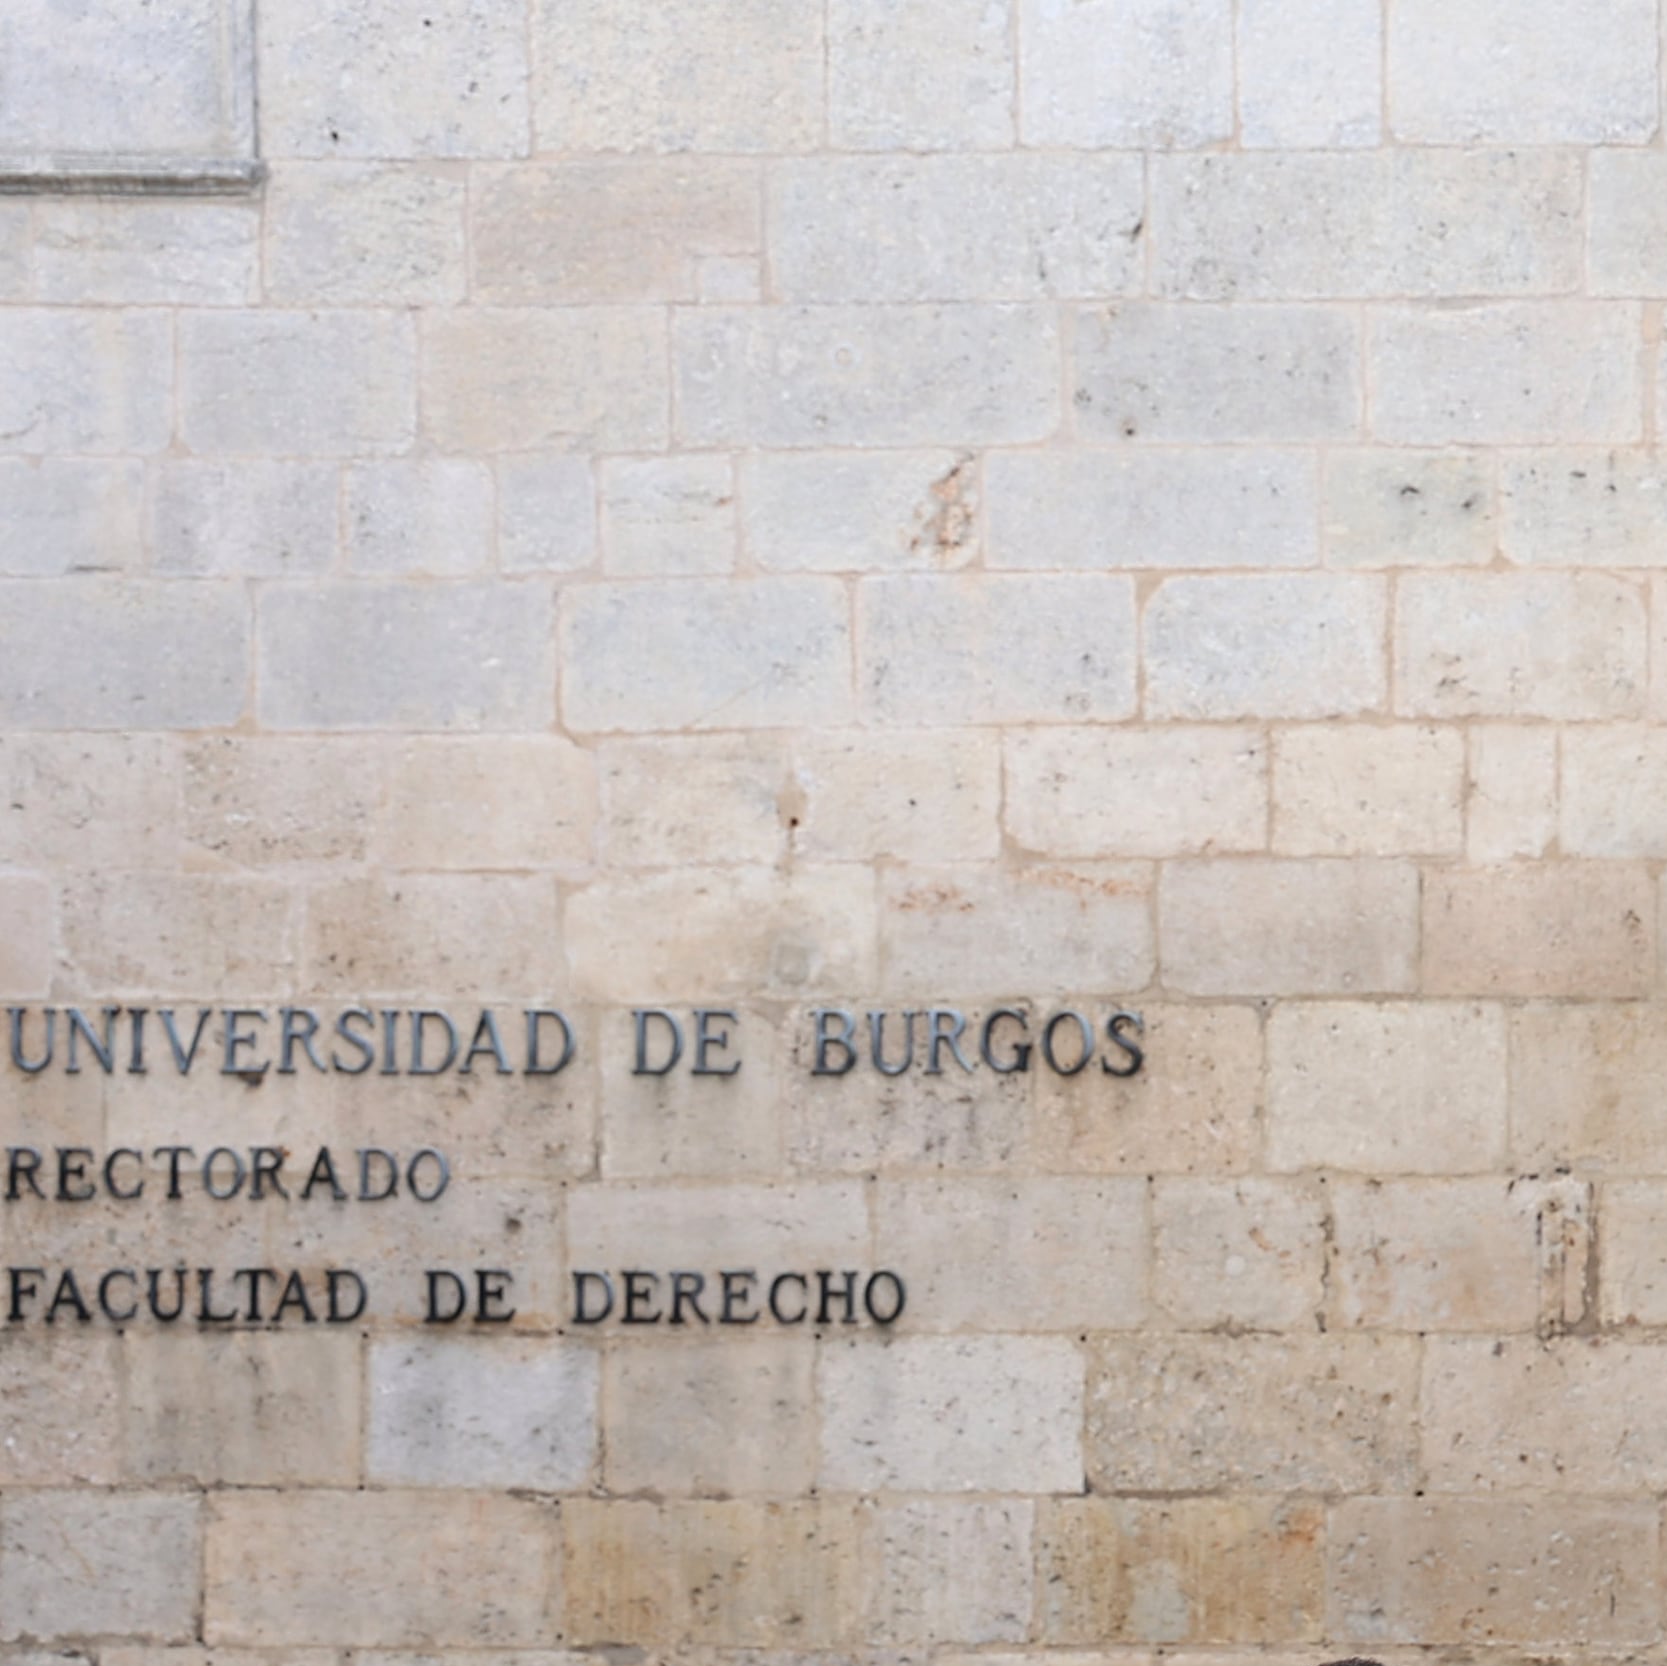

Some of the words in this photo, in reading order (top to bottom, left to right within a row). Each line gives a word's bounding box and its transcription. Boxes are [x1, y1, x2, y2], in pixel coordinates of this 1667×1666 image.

[9, 1008, 576, 1077] UNIVERSIDAD
[631, 1009, 742, 1077] DE
[810, 1009, 1146, 1077] BURGOS
[6, 1147, 451, 1202] RECTORADO
[6, 1269, 367, 1325] FACULTAD
[424, 1270, 516, 1325] DE
[570, 1270, 908, 1326] DERECHO
